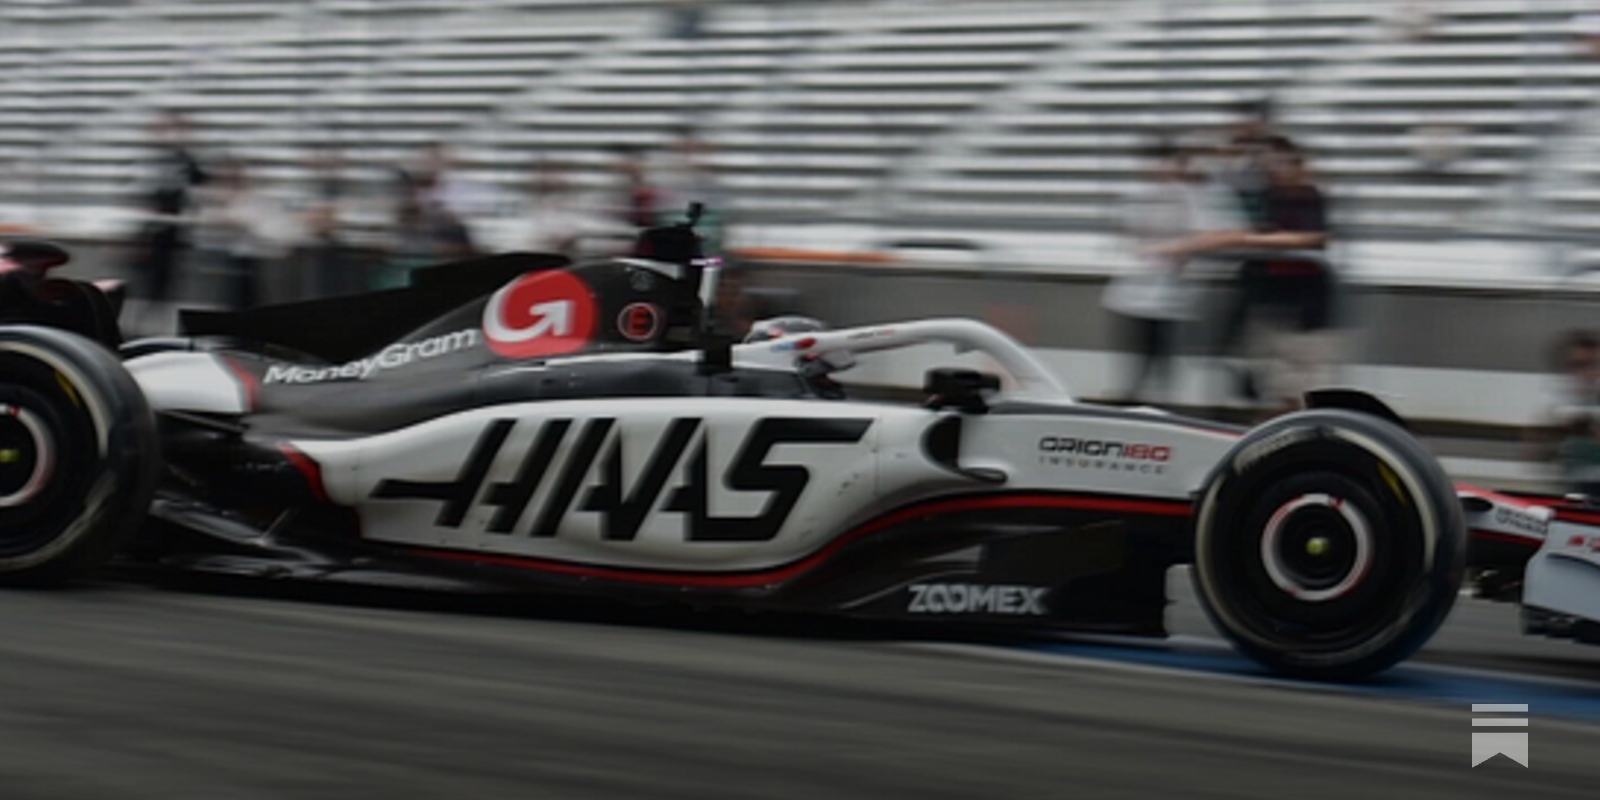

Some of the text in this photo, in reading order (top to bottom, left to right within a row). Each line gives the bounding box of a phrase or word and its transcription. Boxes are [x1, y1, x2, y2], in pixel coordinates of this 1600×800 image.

[629, 305, 654, 336] E
[263, 328, 477, 384] MoneyGram
[369, 417, 874, 542] HAAS
[1039, 456, 1164, 475] INSURANCE
[907, 584, 1050, 615] ZOOMEX
